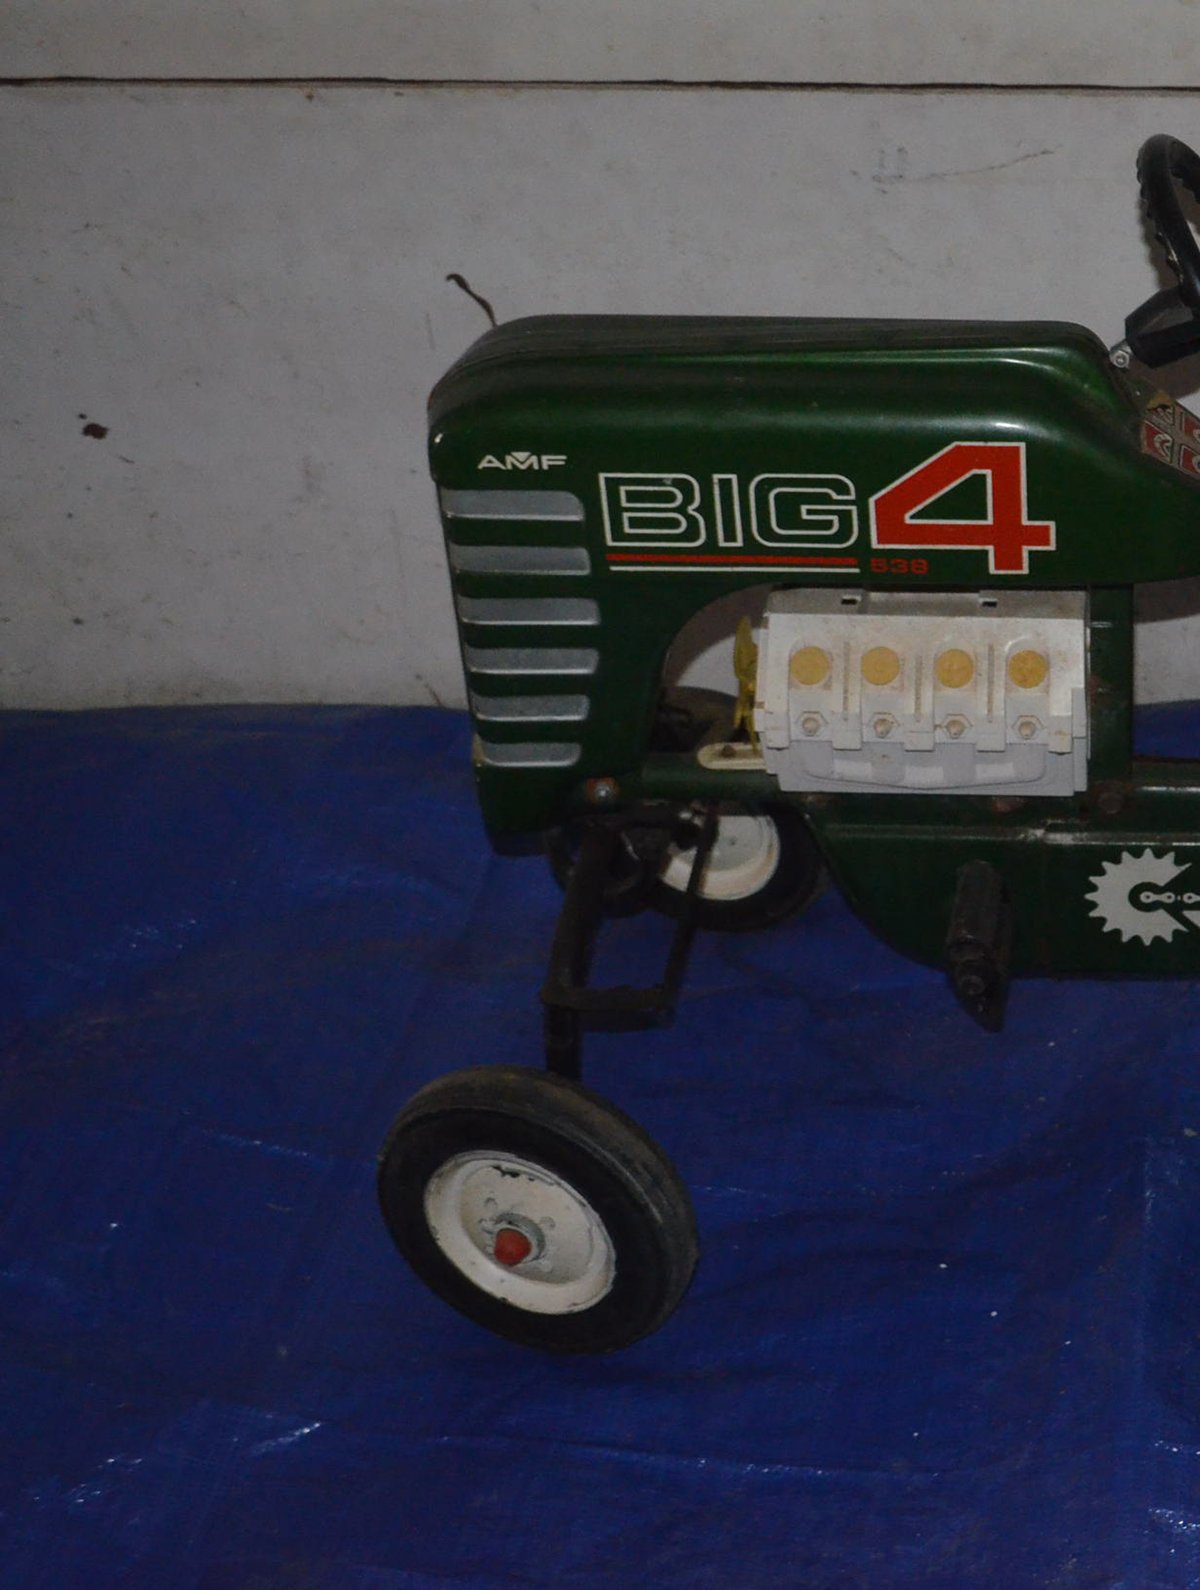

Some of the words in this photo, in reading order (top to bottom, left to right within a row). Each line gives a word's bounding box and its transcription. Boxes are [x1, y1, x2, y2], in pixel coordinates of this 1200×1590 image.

[477, 451, 568, 470] AMF
[598, 473, 858, 548] BIG
[868, 441, 1056, 575] 4
